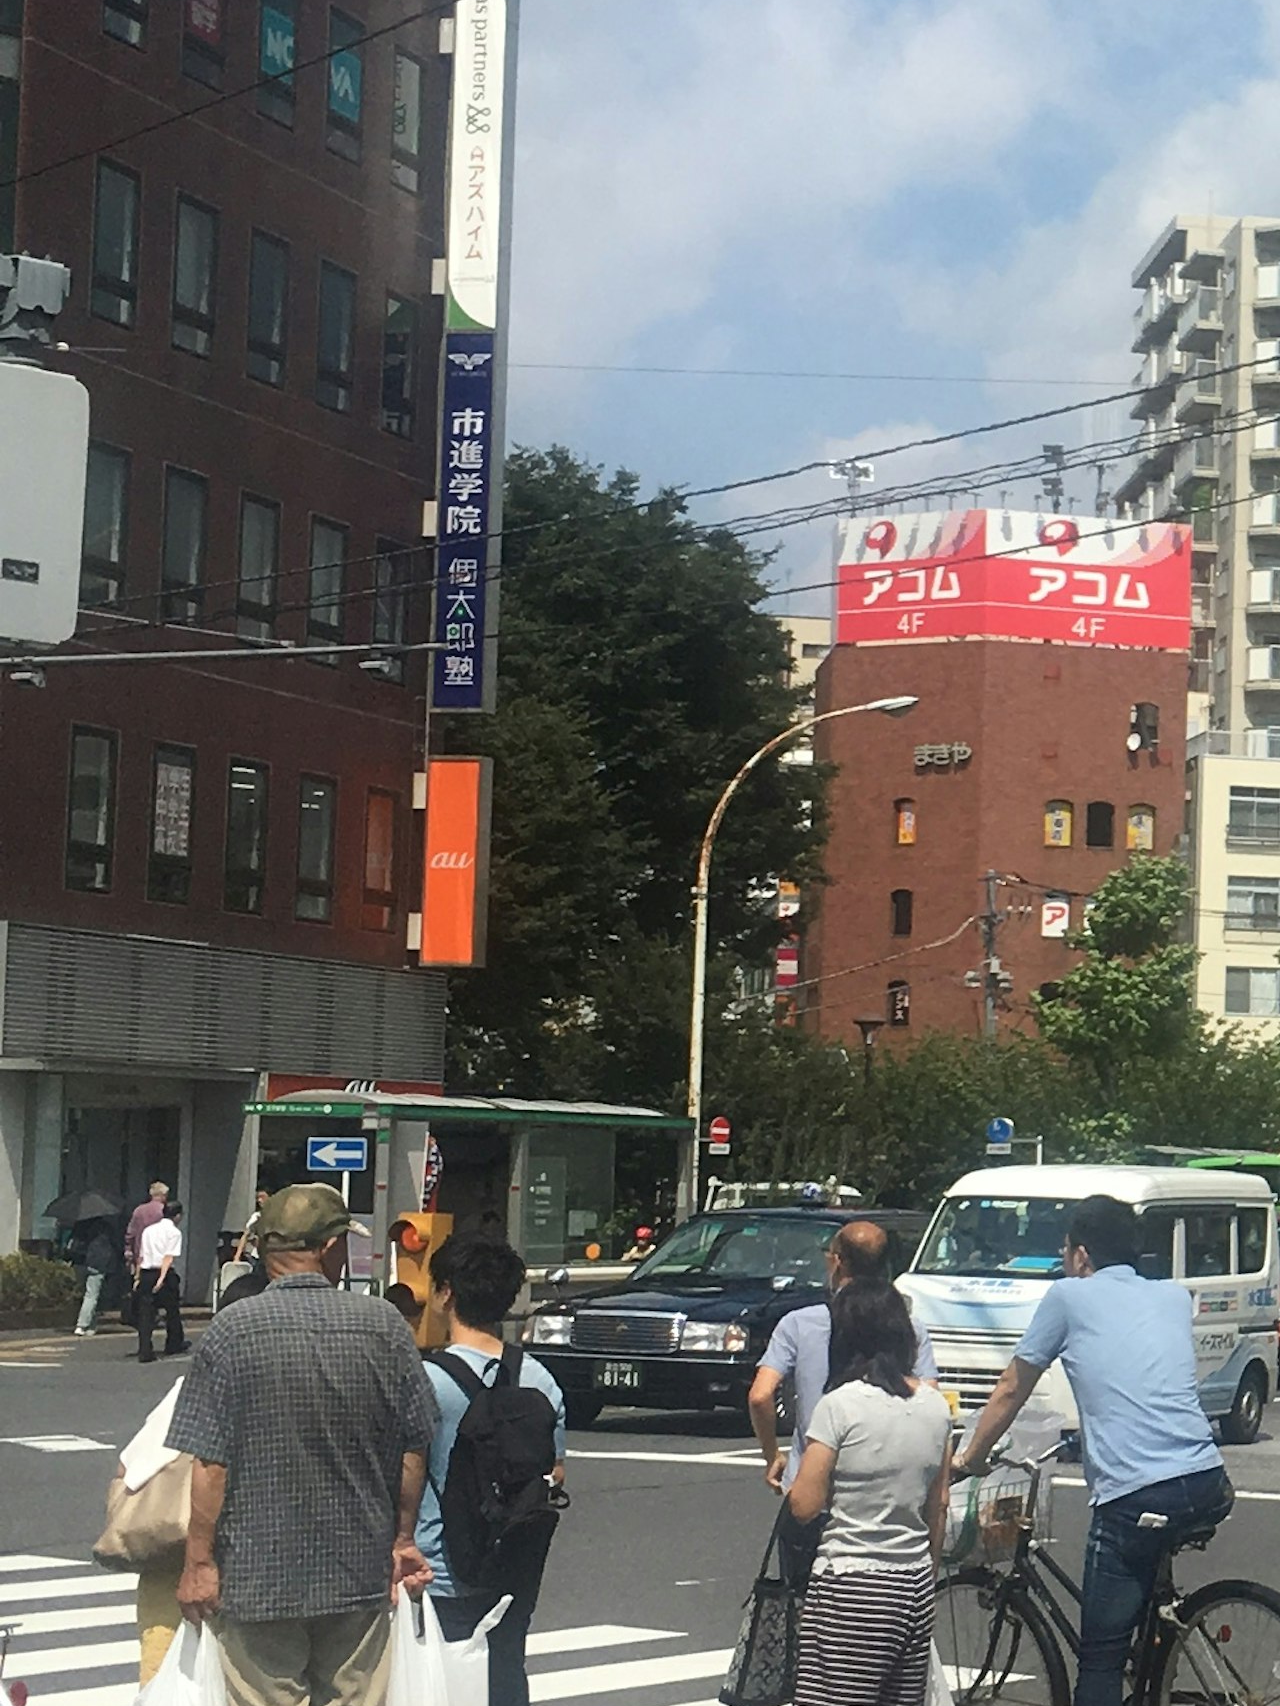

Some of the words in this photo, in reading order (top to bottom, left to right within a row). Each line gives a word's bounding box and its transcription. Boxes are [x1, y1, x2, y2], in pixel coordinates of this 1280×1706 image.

[472, 18, 489, 101] partners
[465, 165, 486, 261] アズハイム
[446, 407, 486, 535] 市進学院
[863, 564, 961, 606] アコム
[1028, 566, 1150, 610] アコム
[896, 612, 925, 635] 4F
[1070, 616, 1105, 638] 4F
[430, 850, 474, 870] au
